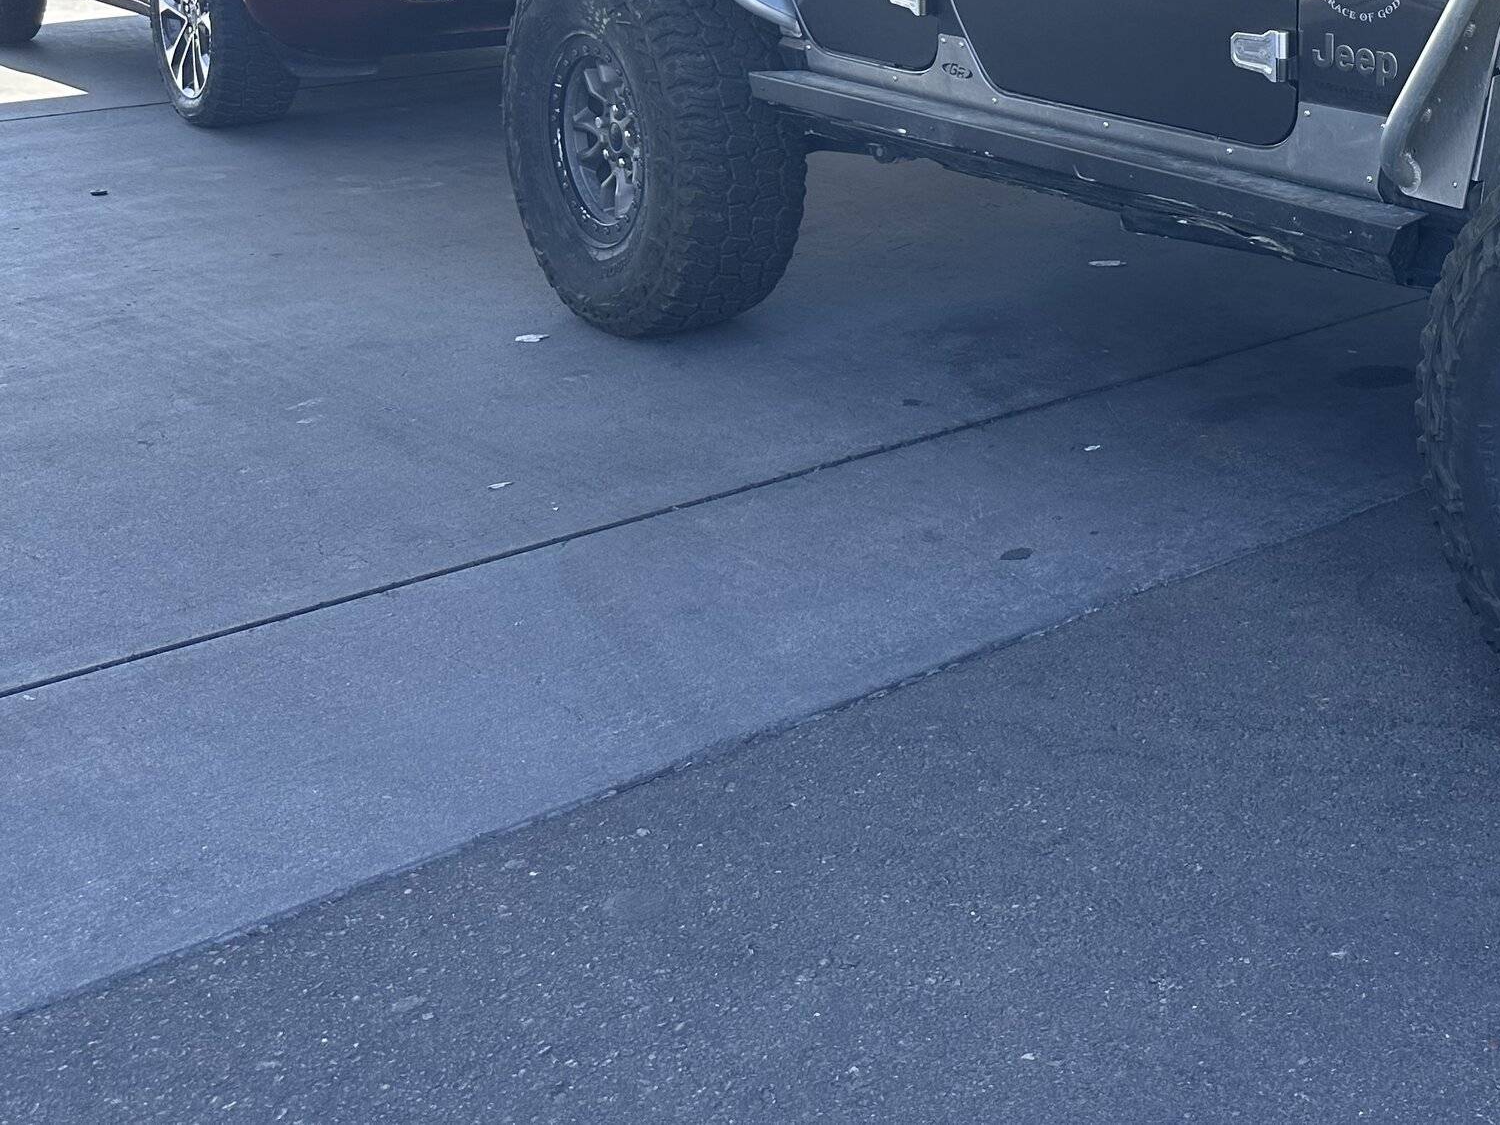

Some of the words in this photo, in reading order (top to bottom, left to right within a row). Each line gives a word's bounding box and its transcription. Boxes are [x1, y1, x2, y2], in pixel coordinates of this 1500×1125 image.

[1359, 12, 1374, 22] OF
[1378, 0, 1401, 19] GOD
[1312, 33, 1398, 86] Jeep
